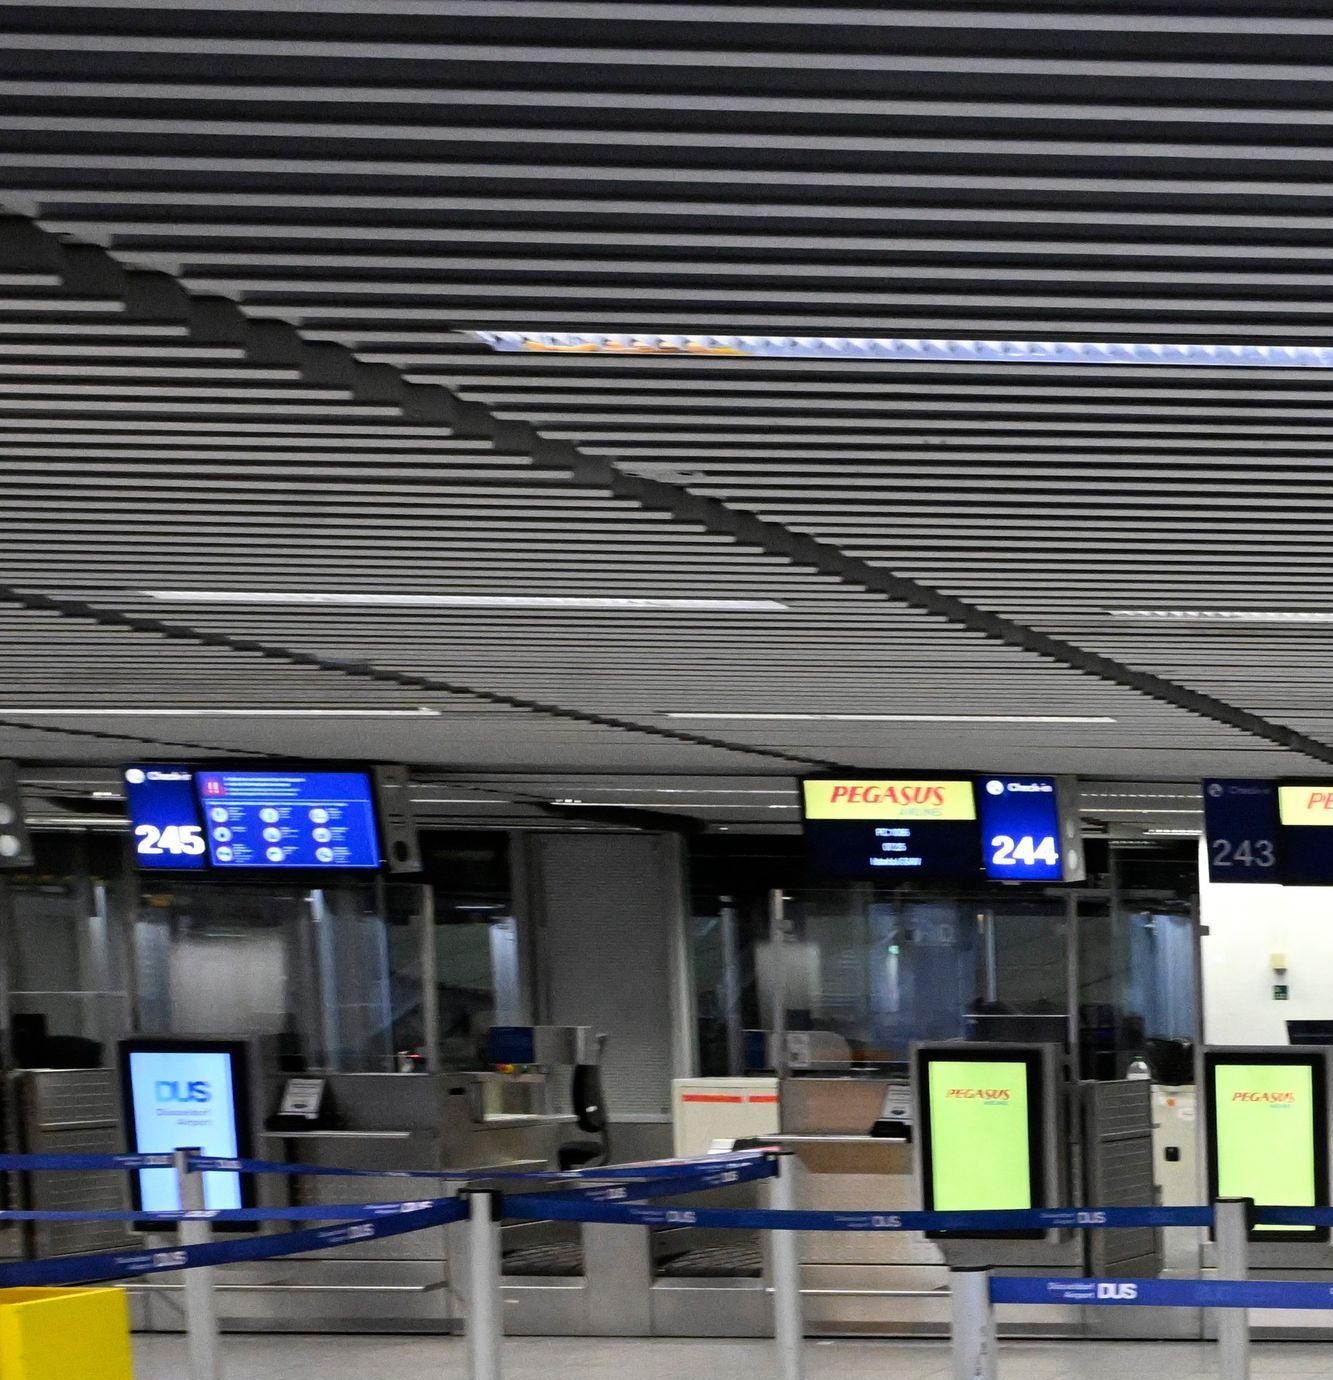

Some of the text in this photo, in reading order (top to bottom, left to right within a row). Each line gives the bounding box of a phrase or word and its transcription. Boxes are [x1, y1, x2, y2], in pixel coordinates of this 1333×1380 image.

[830, 786, 945, 806] PEGASUS
[134, 825, 205, 854] 245
[991, 836, 1059, 866] 244
[1212, 840, 1276, 867] 243
[154, 1081, 210, 1102] DUS
[945, 1089, 1011, 1100] PEGASUS
[1231, 1092, 1295, 1104] PEGASUS
[1076, 1211, 1106, 1224] DUS
[1098, 1283, 1137, 1300] DUS
